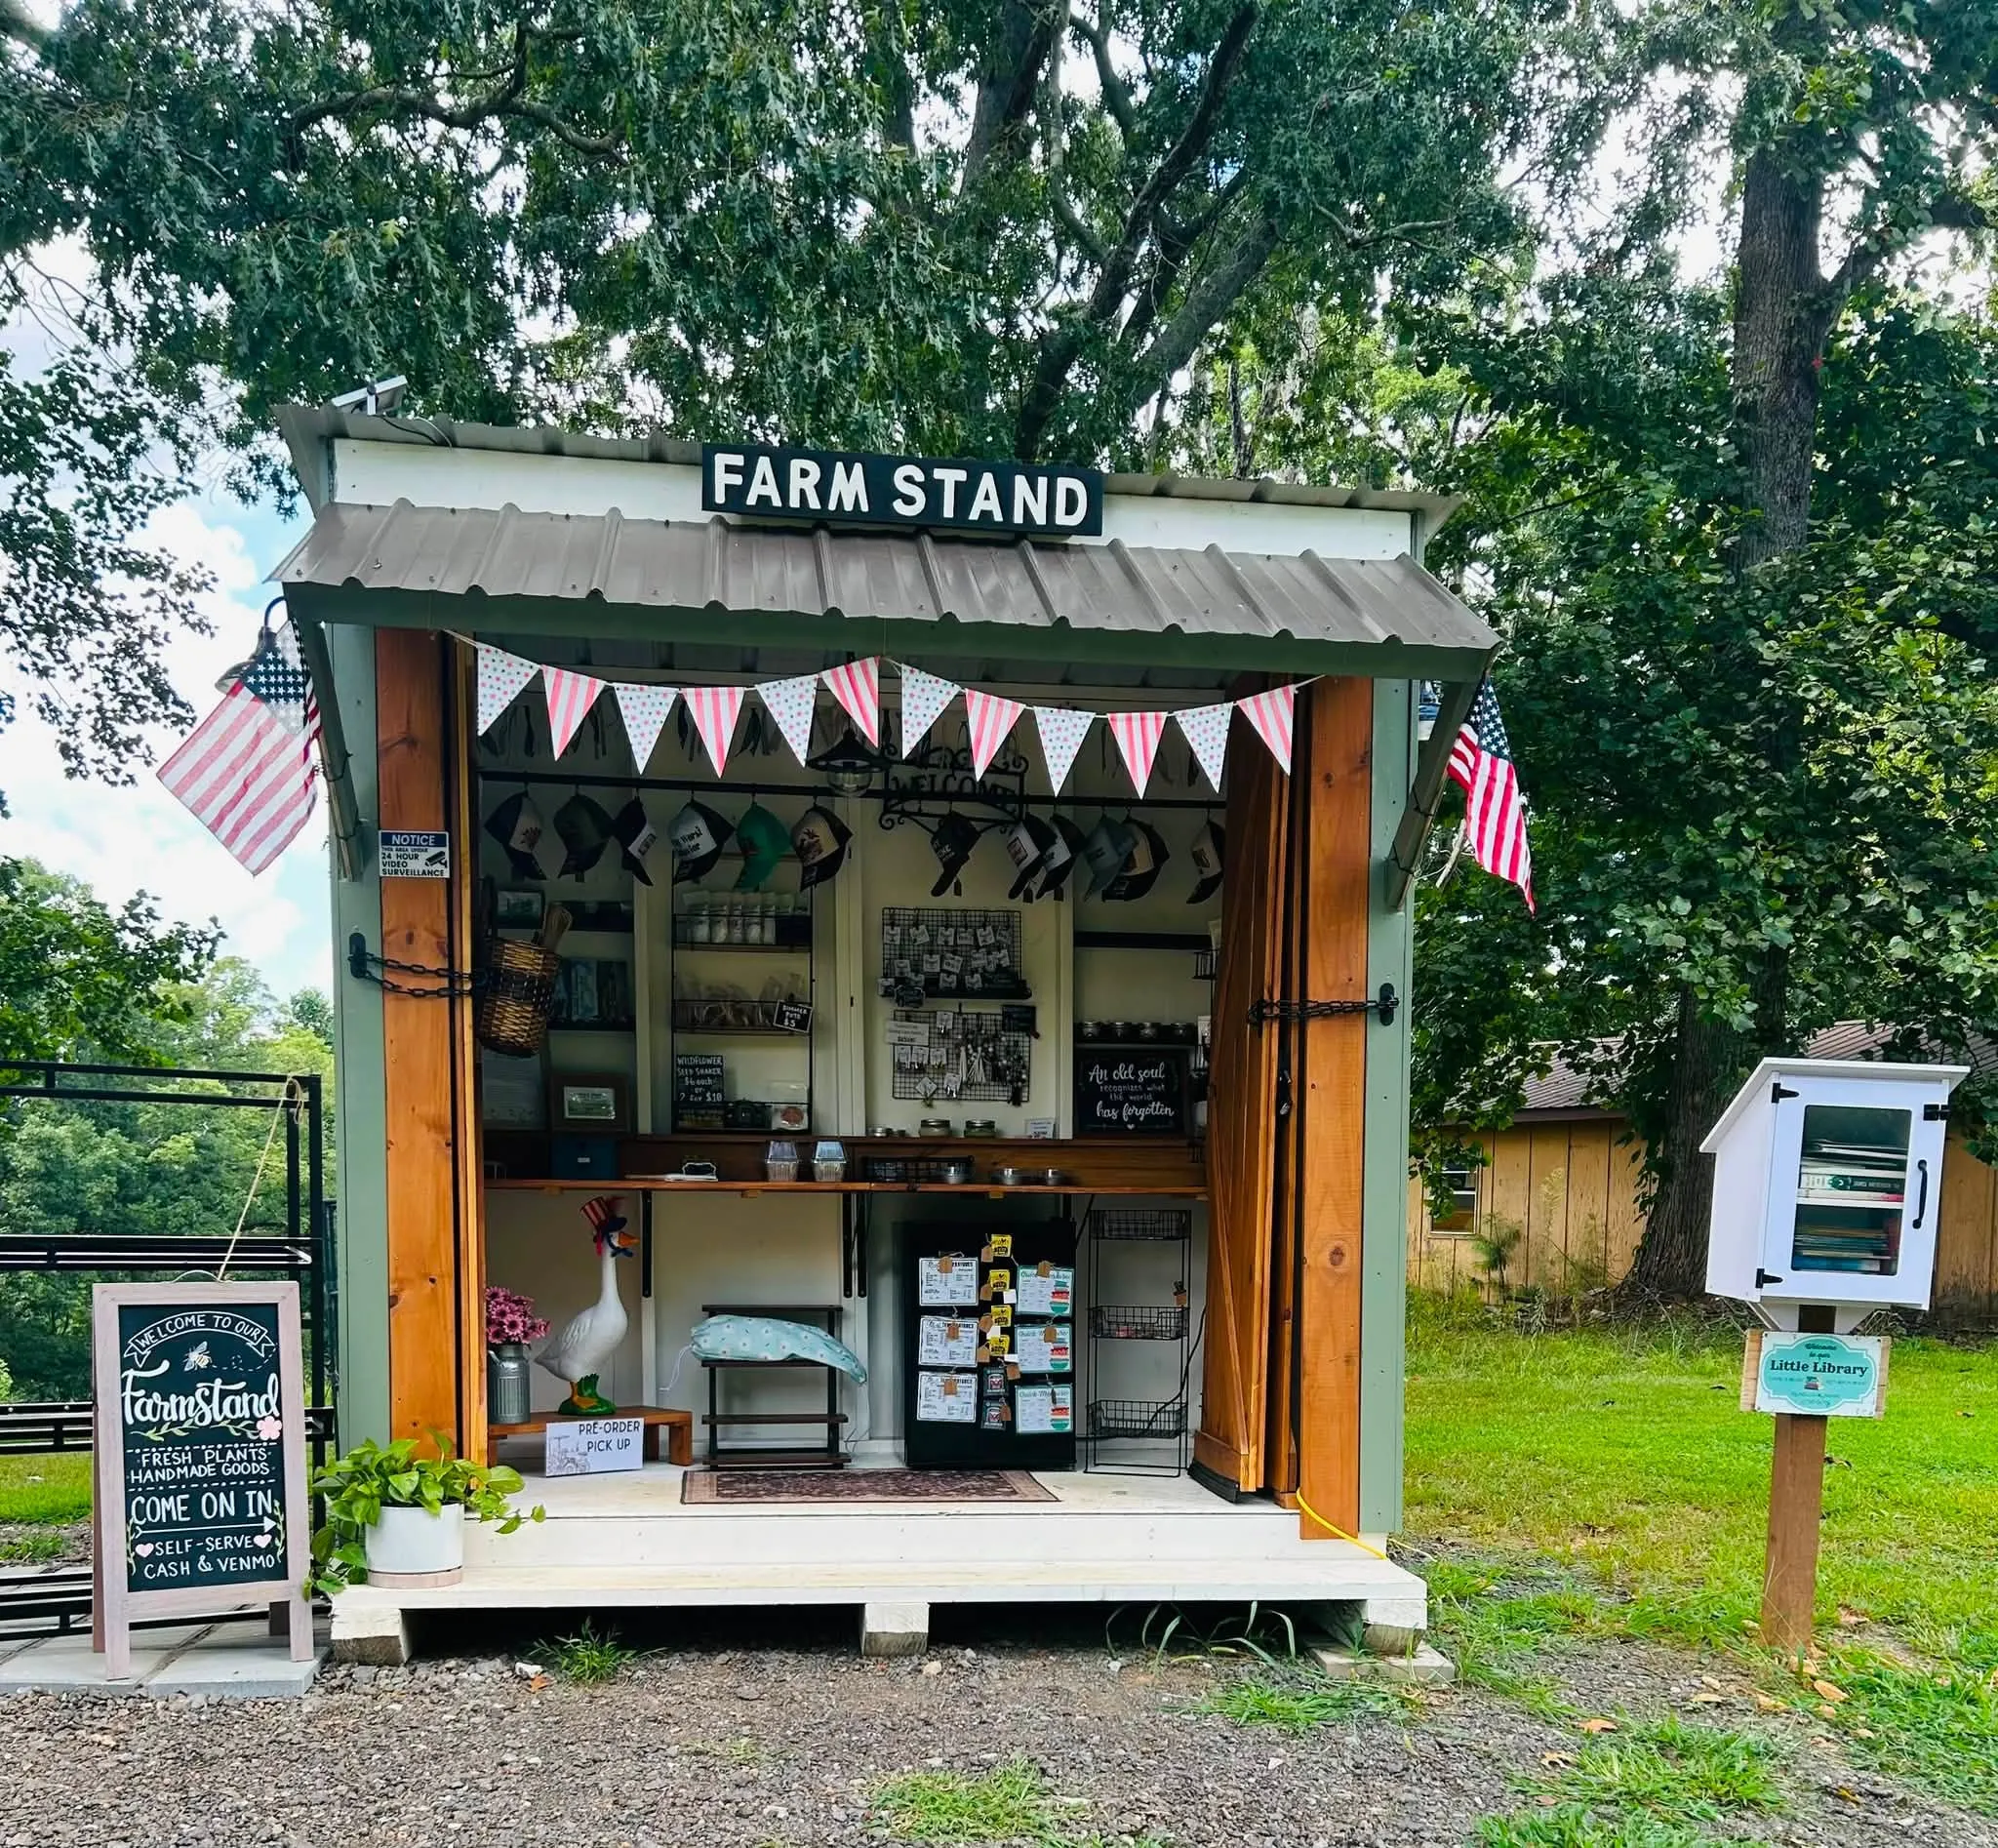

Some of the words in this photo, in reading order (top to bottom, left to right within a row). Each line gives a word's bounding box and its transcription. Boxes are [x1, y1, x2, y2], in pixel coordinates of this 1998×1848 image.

[714, 453, 869, 512] FARM
[893, 464, 1088, 526] STAND
[391, 834, 436, 846] NOTICE
[381, 867, 444, 876] SURVEILLANCE
[677, 1056, 723, 1065] WILDFLOWER
[1089, 1064, 1108, 1085] An
[1112, 1062, 1136, 1080] old
[1138, 1061, 1165, 1082] soul
[705, 1091, 723, 1103] $10
[1096, 1100, 1119, 1120] has
[1122, 1101, 1176, 1122] forgotten
[135, 1314, 206, 1348] WELCOME
[213, 1315, 231, 1329] TO
[234, 1320, 261, 1342] OUR
[1770, 1359, 1810, 1373] Little
[1813, 1361, 1868, 1378] Library
[579, 1421, 641, 1435] PRE-ORDER
[587, 1439, 613, 1452] PICK
[617, 1438, 631, 1451] UP
[141, 1451, 192, 1467] FRESH
[204, 1448, 267, 1464] PLANTS
[131, 1463, 217, 1484] HANDMADE
[221, 1462, 270, 1476] GOODS
[131, 1494, 191, 1525] COME
[201, 1490, 235, 1519] ON
[245, 1489, 272, 1518] IN
[155, 1535, 254, 1557] SELF-SERVE
[144, 1558, 190, 1580] CASH
[197, 1554, 214, 1573] &
[217, 1552, 275, 1574] VENMO
